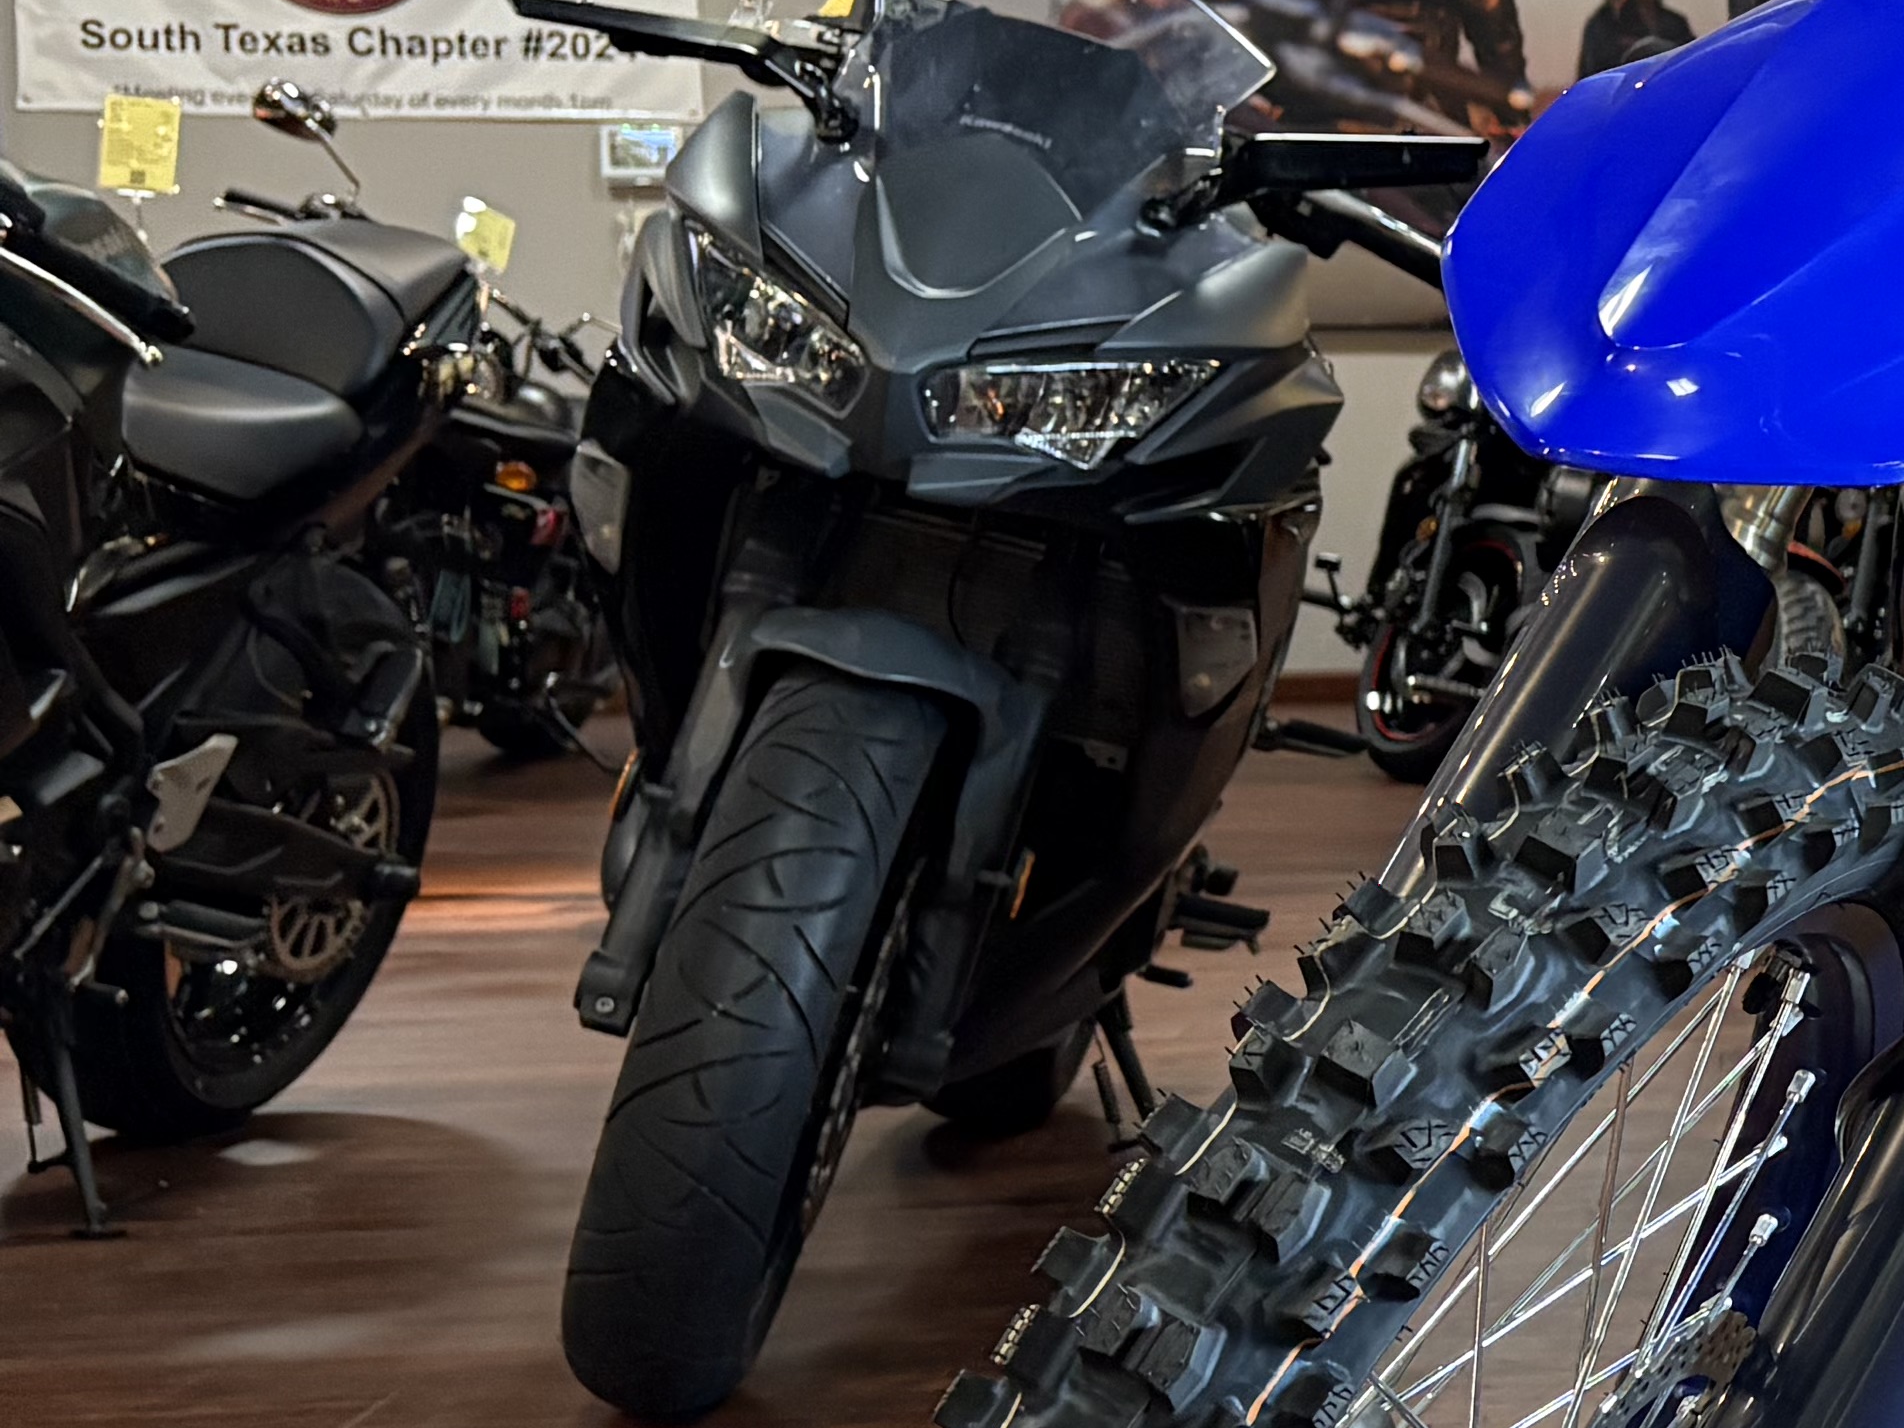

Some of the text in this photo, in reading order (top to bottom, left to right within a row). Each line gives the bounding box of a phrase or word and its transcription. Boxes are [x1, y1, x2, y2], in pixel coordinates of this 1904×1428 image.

[80, 19, 637, 65] South Texas Chapter #202
